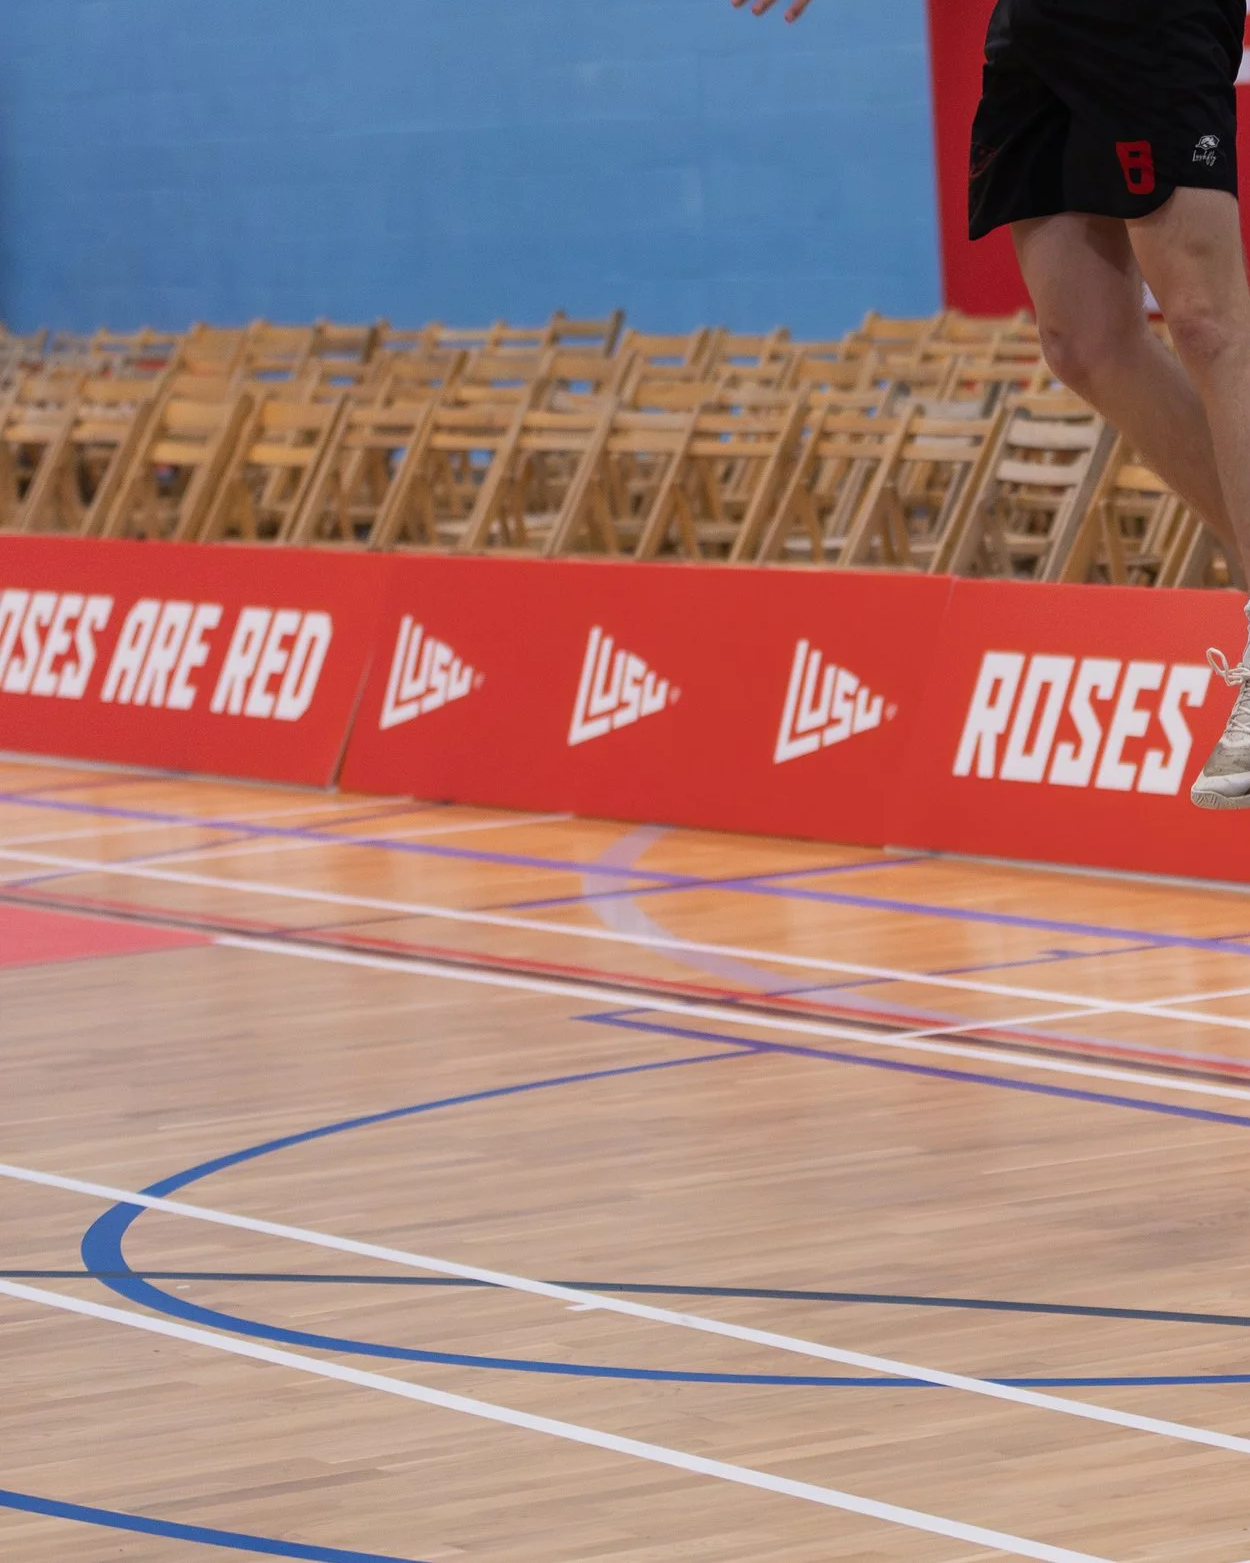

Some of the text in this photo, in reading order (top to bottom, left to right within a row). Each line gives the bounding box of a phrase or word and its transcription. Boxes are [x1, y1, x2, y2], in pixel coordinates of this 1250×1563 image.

[100, 598, 223, 710] ARE
[209, 605, 332, 722] RED
[953, 651, 1212, 796] ROSES
